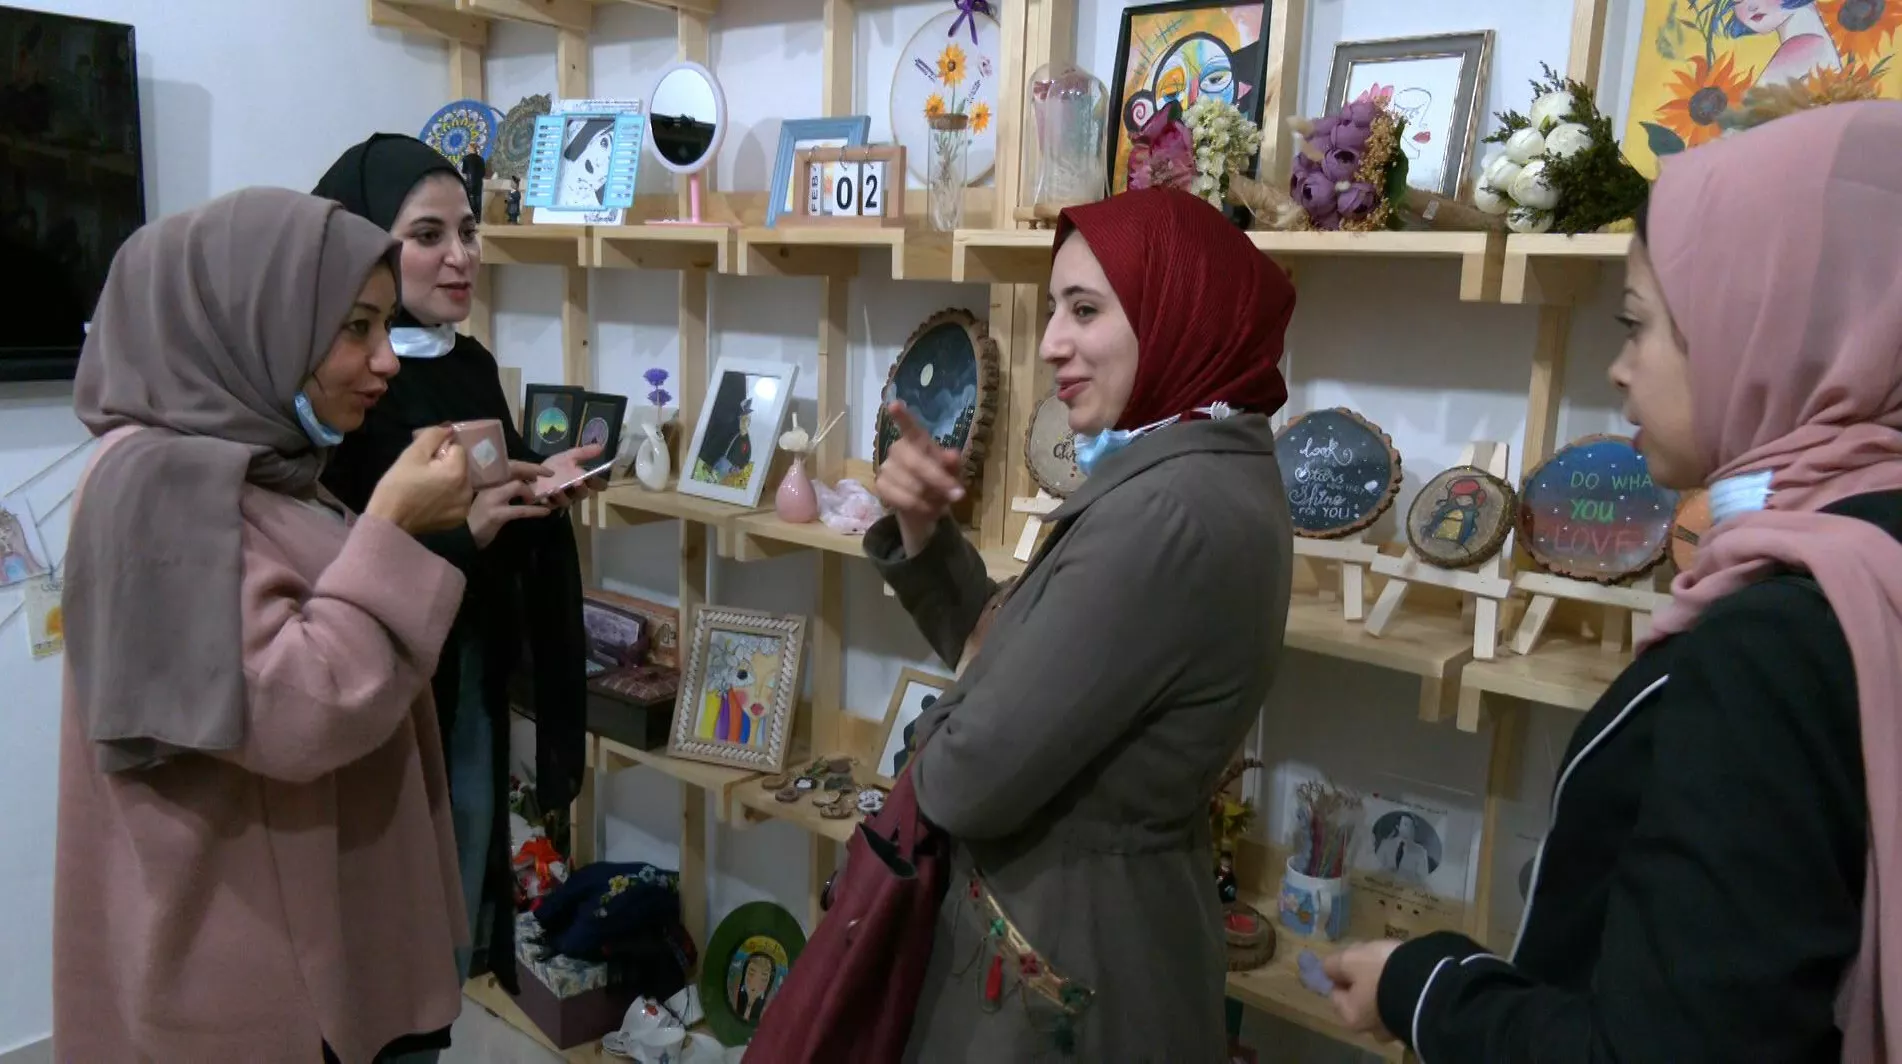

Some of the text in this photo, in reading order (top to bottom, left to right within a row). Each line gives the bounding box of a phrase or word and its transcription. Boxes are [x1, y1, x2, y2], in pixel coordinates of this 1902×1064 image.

[811, 175, 819, 212] FEB
[1570, 470, 1654, 491] DO WHA
[1322, 506, 1350, 519] YOU
[1570, 498, 1616, 523] YOU
